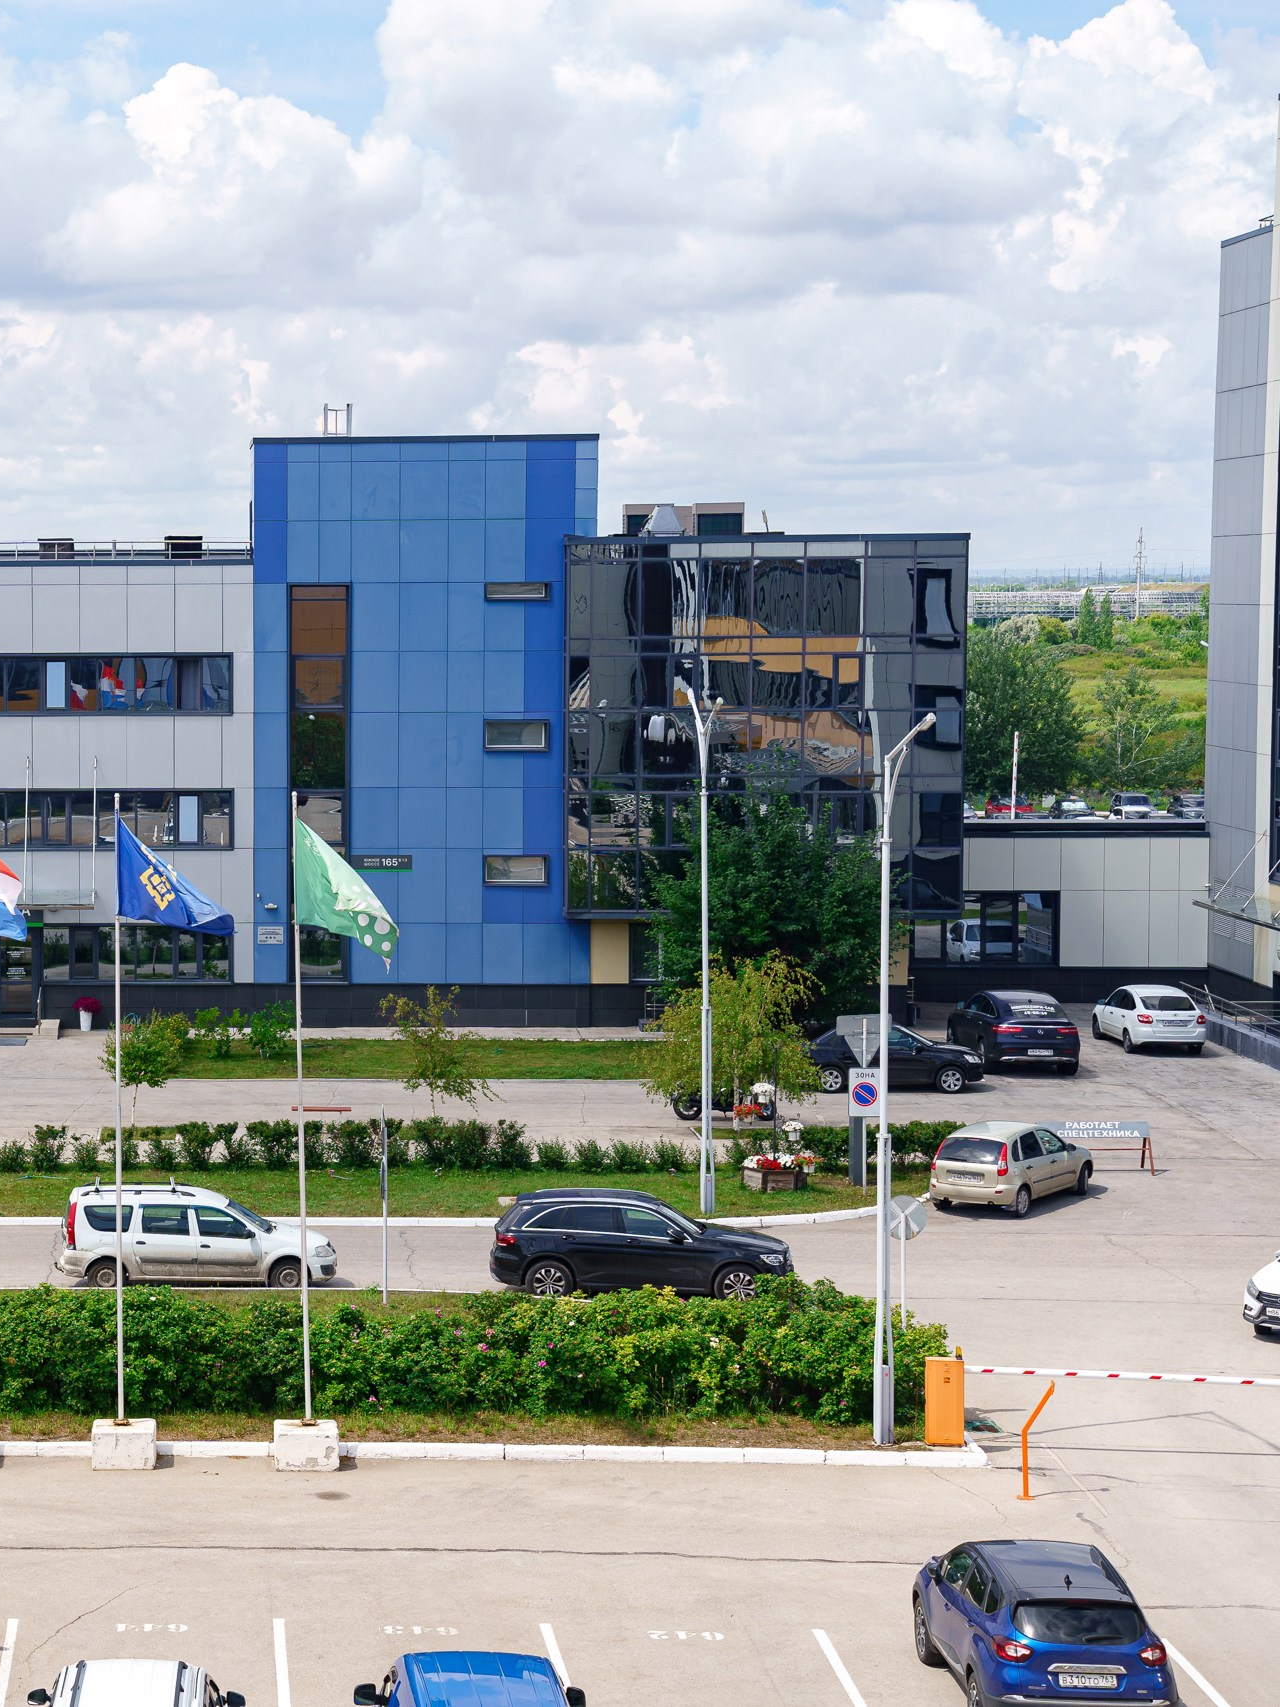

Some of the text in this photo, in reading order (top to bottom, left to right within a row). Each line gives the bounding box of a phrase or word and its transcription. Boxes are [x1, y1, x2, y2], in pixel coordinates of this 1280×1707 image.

[381, 858, 398, 866] 165
[1065, 1121, 1121, 1129] РАБОТАЕТ
[1057, 1130, 1140, 1138] СПЕЦТЕХНИКА
[114, 1623, 189, 1632] 644
[383, 1625, 459, 1636] 643
[647, 1630, 724, 1641] 642
